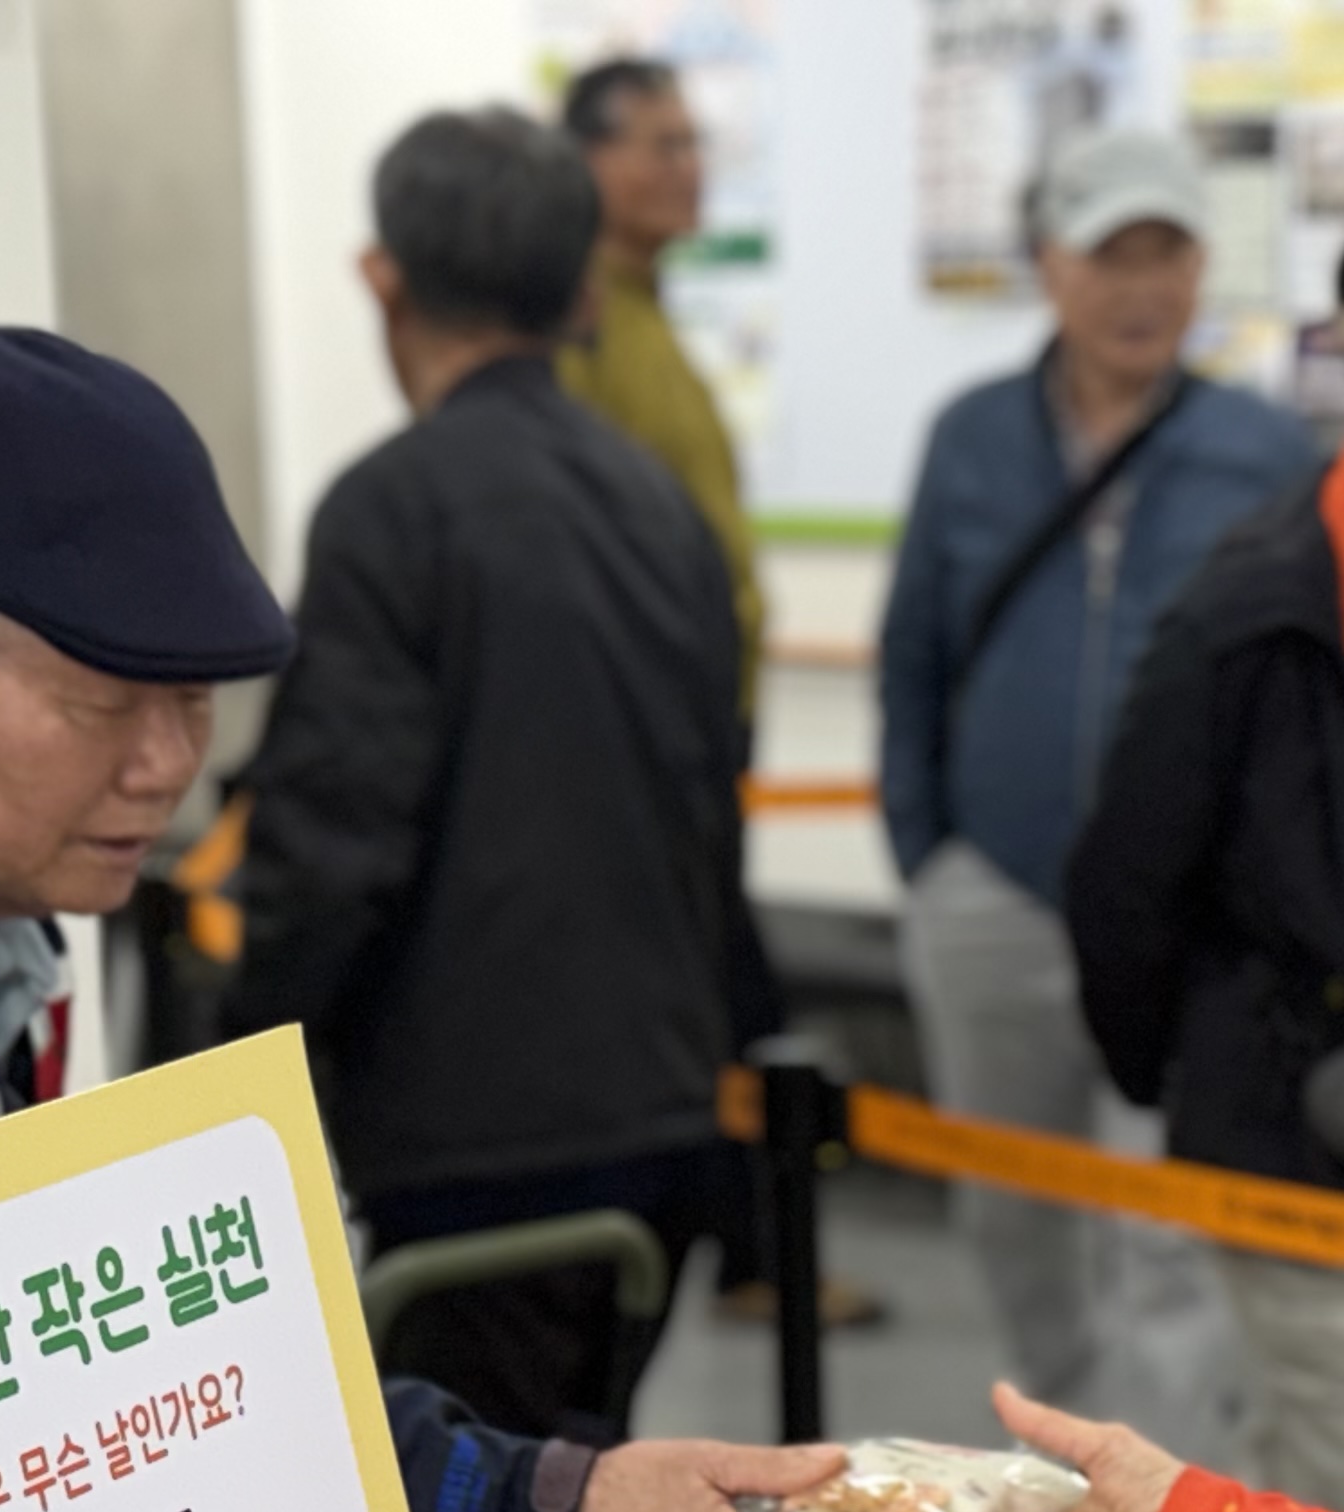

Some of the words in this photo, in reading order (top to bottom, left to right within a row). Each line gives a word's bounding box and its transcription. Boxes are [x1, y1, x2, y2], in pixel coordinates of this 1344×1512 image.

[22, 1245, 149, 1366] 작은
[157, 1196, 269, 1326] 실천
[19, 1432, 92, 1512] 무슨
[94, 1364, 246, 1482] 날인가요?
